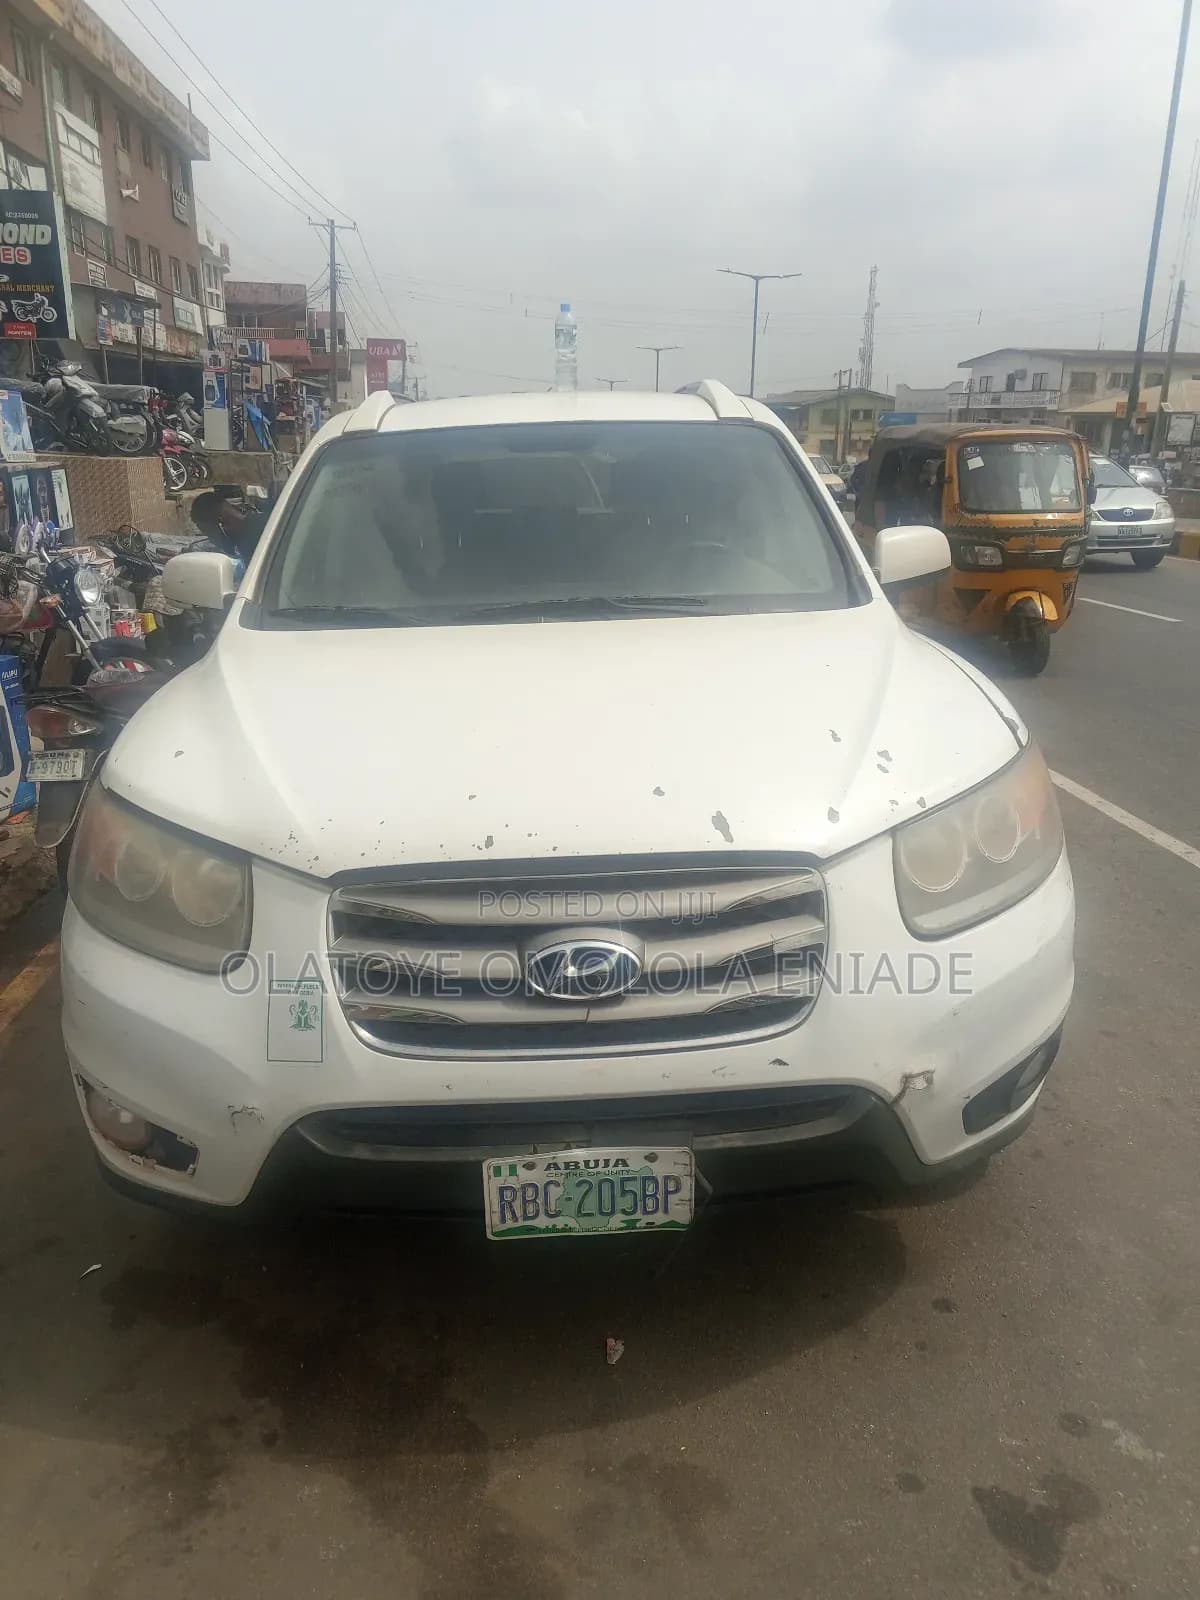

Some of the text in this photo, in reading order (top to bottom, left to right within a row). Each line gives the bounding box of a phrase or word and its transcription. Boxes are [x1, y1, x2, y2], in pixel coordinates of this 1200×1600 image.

[0, 222, 52, 245] OND
[544, 1158, 630, 1171] ABUJA
[546, 1170, 585, 1178] CENTRE
[498, 1175, 682, 1224] RBC-205BP
